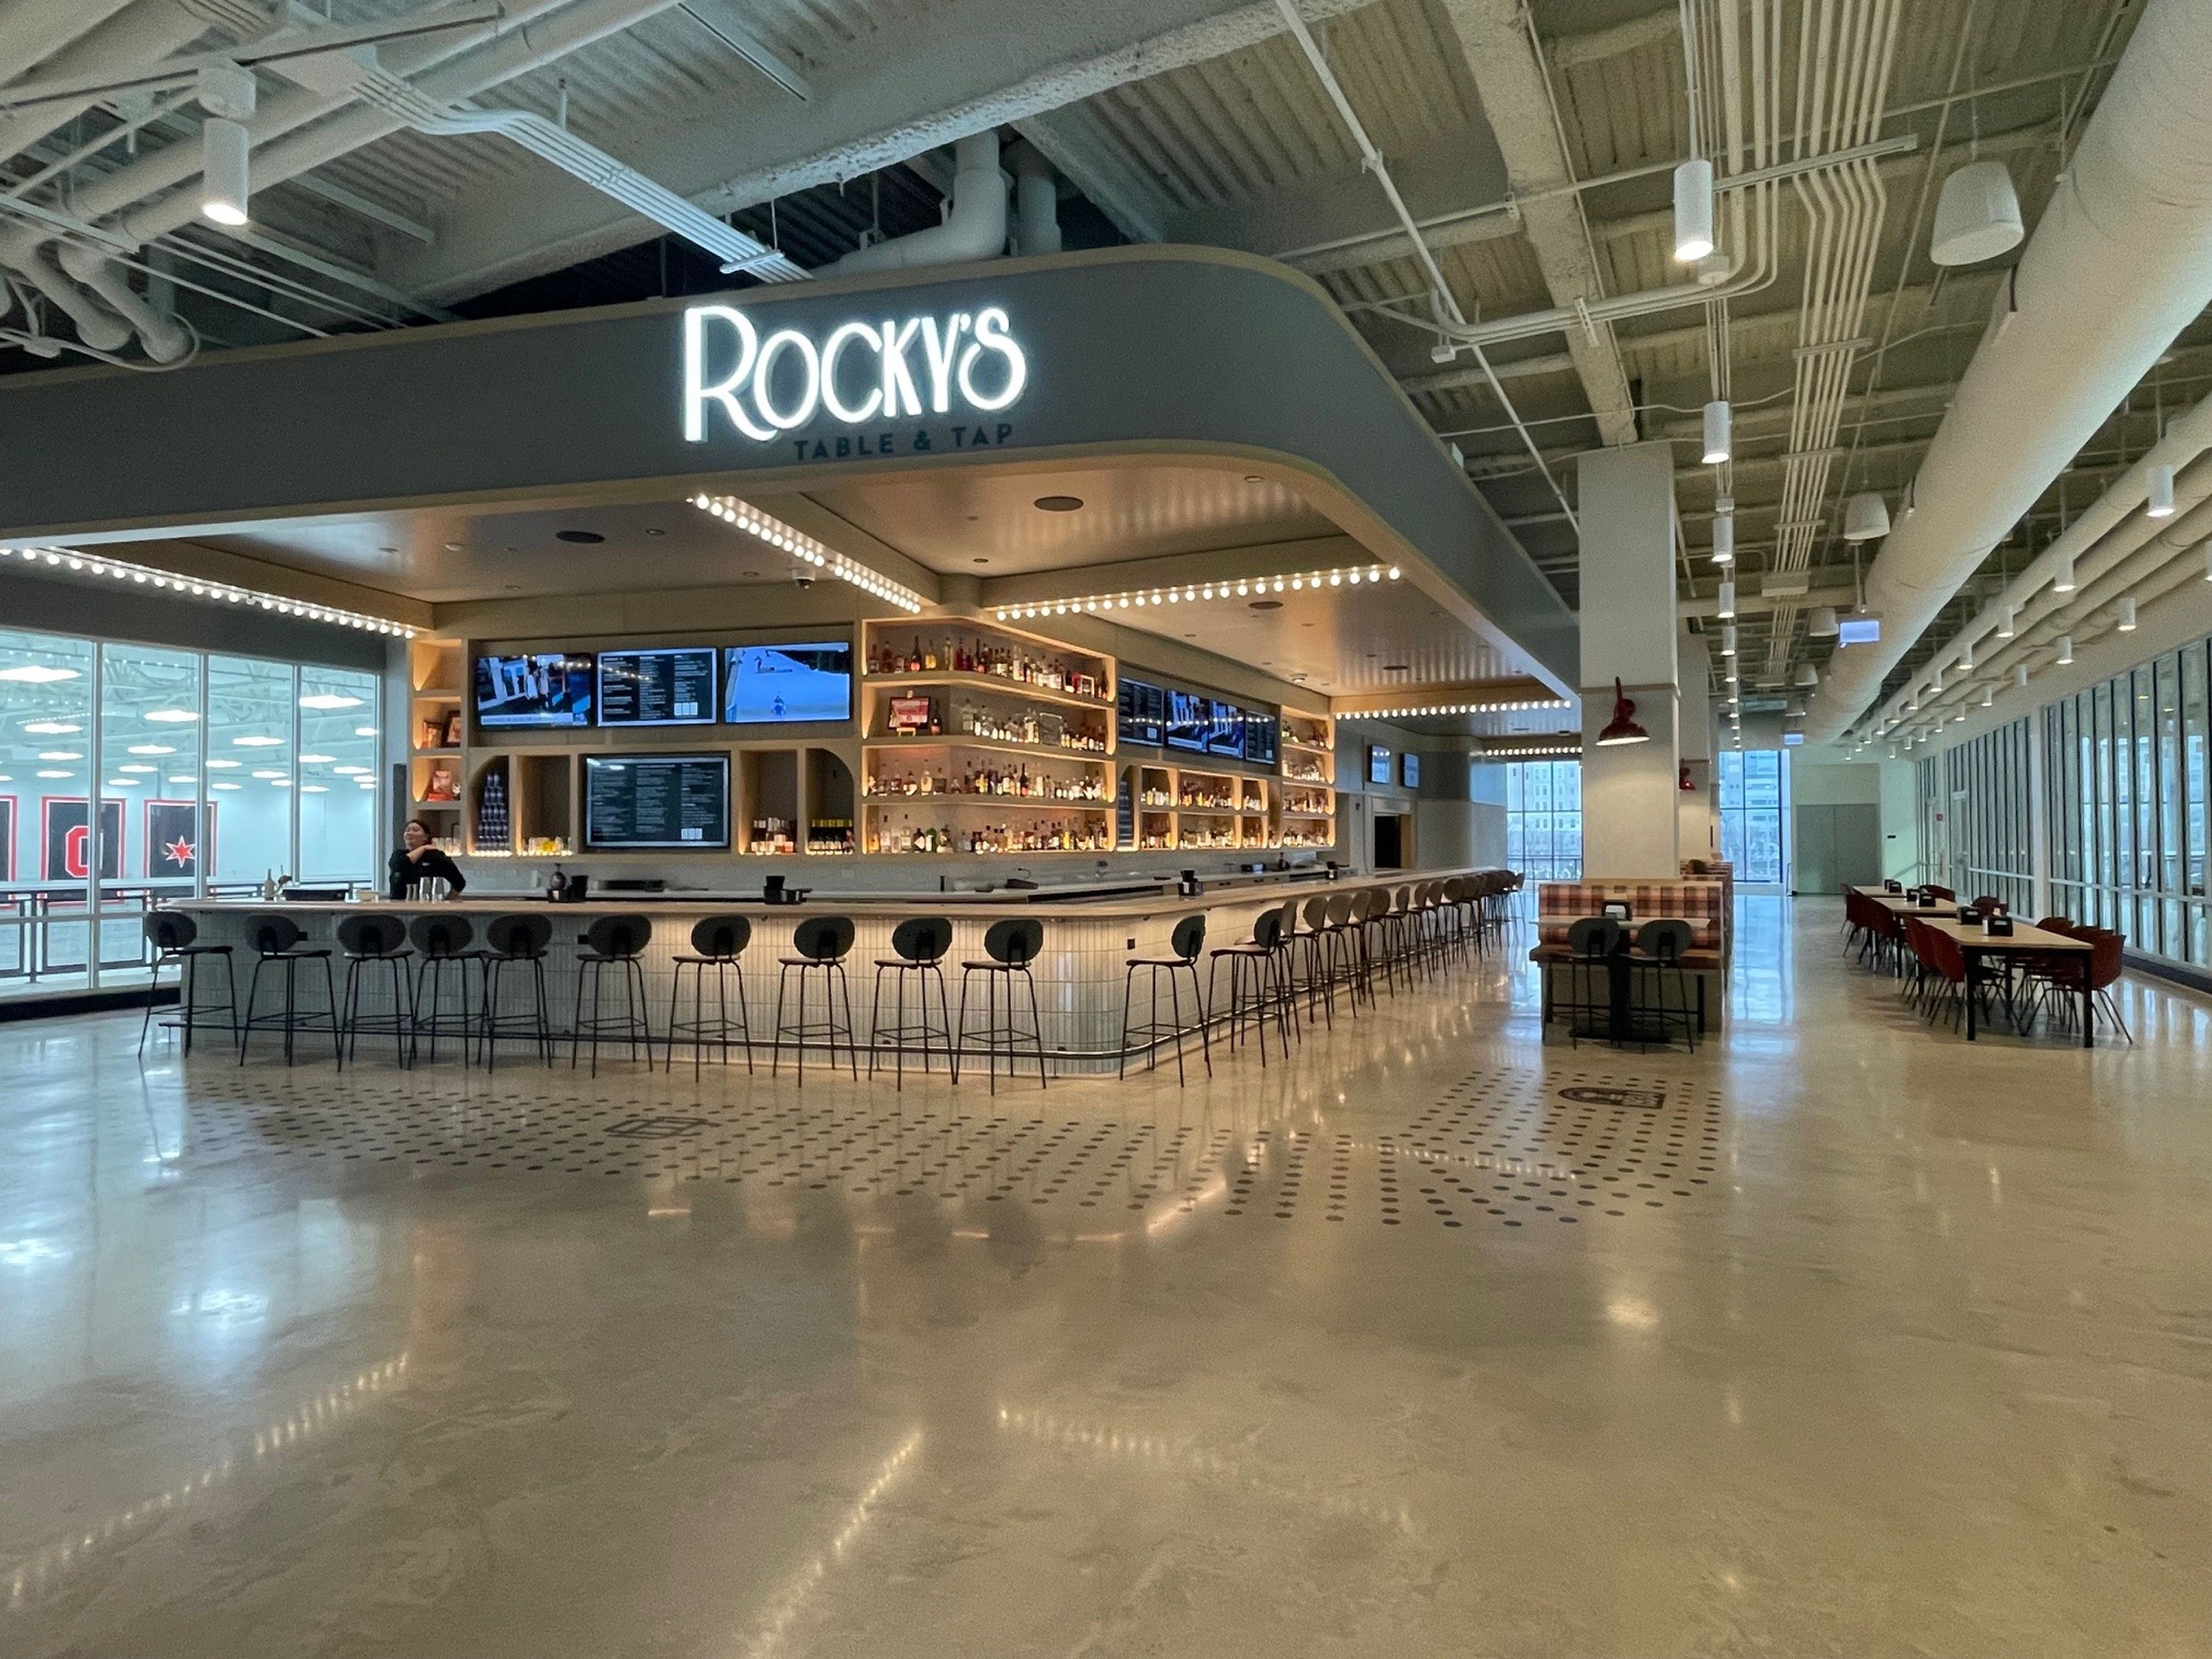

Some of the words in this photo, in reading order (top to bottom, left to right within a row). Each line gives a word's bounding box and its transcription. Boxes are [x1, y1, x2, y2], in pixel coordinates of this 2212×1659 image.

[684, 306, 1027, 441] ROCKY'S
[794, 433, 895, 460] TABLE
[913, 429, 931, 451] &
[950, 423, 1013, 448] TAP
